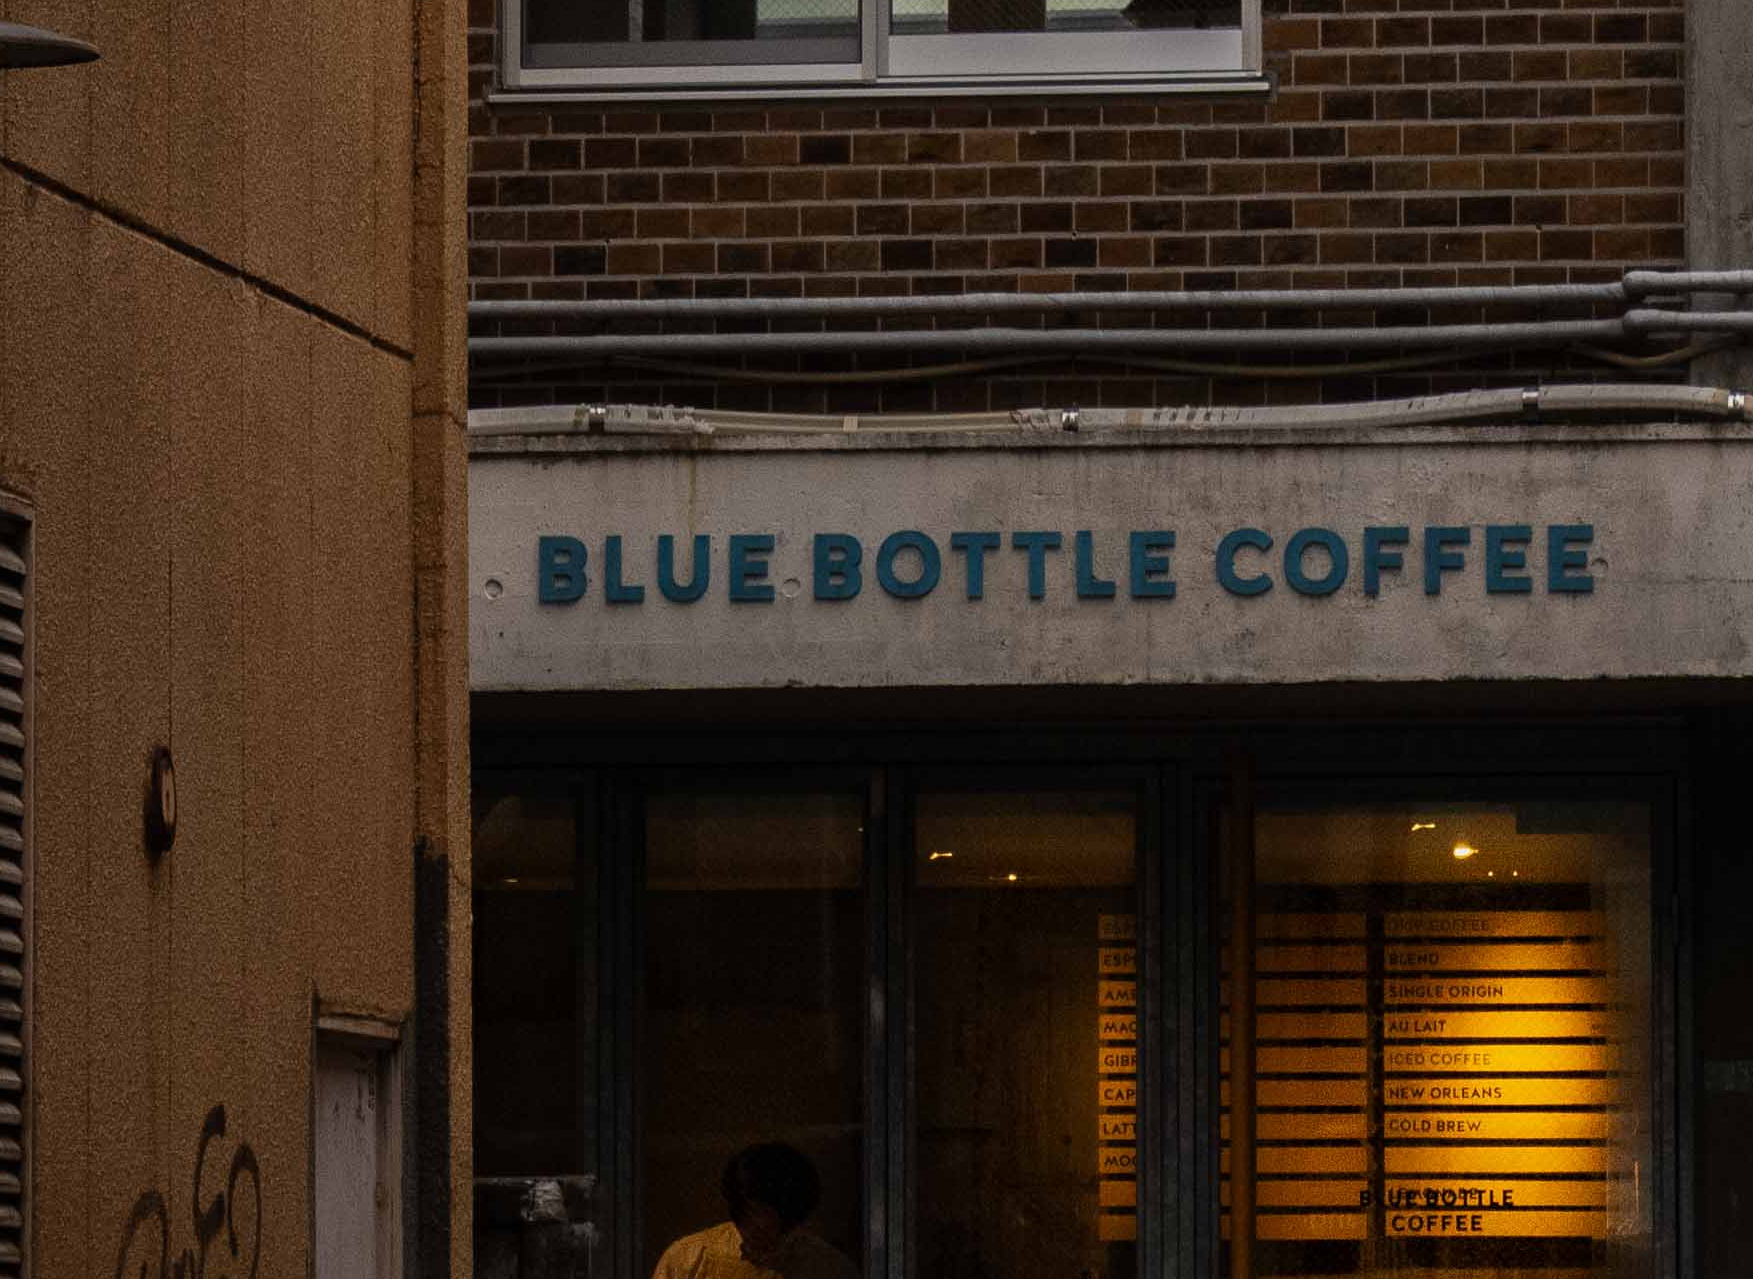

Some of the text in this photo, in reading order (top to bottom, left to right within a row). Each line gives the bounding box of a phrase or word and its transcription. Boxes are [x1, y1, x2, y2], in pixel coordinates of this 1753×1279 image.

[539, 524, 1594, 604] BLUE BOTTLE COFFEE
[1389, 953, 1439, 965] BLEND
[1389, 985, 1503, 998] SINGLE ORIGIN
[1389, 1020, 1447, 1032] AU LAIT
[1389, 1053, 1492, 1065] ICED COFFEE
[1389, 1087, 1503, 1099] NEW ORLEANS
[1389, 1120, 1481, 1132] COLD BREW
[1359, 1189, 1417, 1208] BUE
[1426, 1188, 1514, 1208] BOTTLE
[1391, 1214, 1483, 1232] COFFEE
